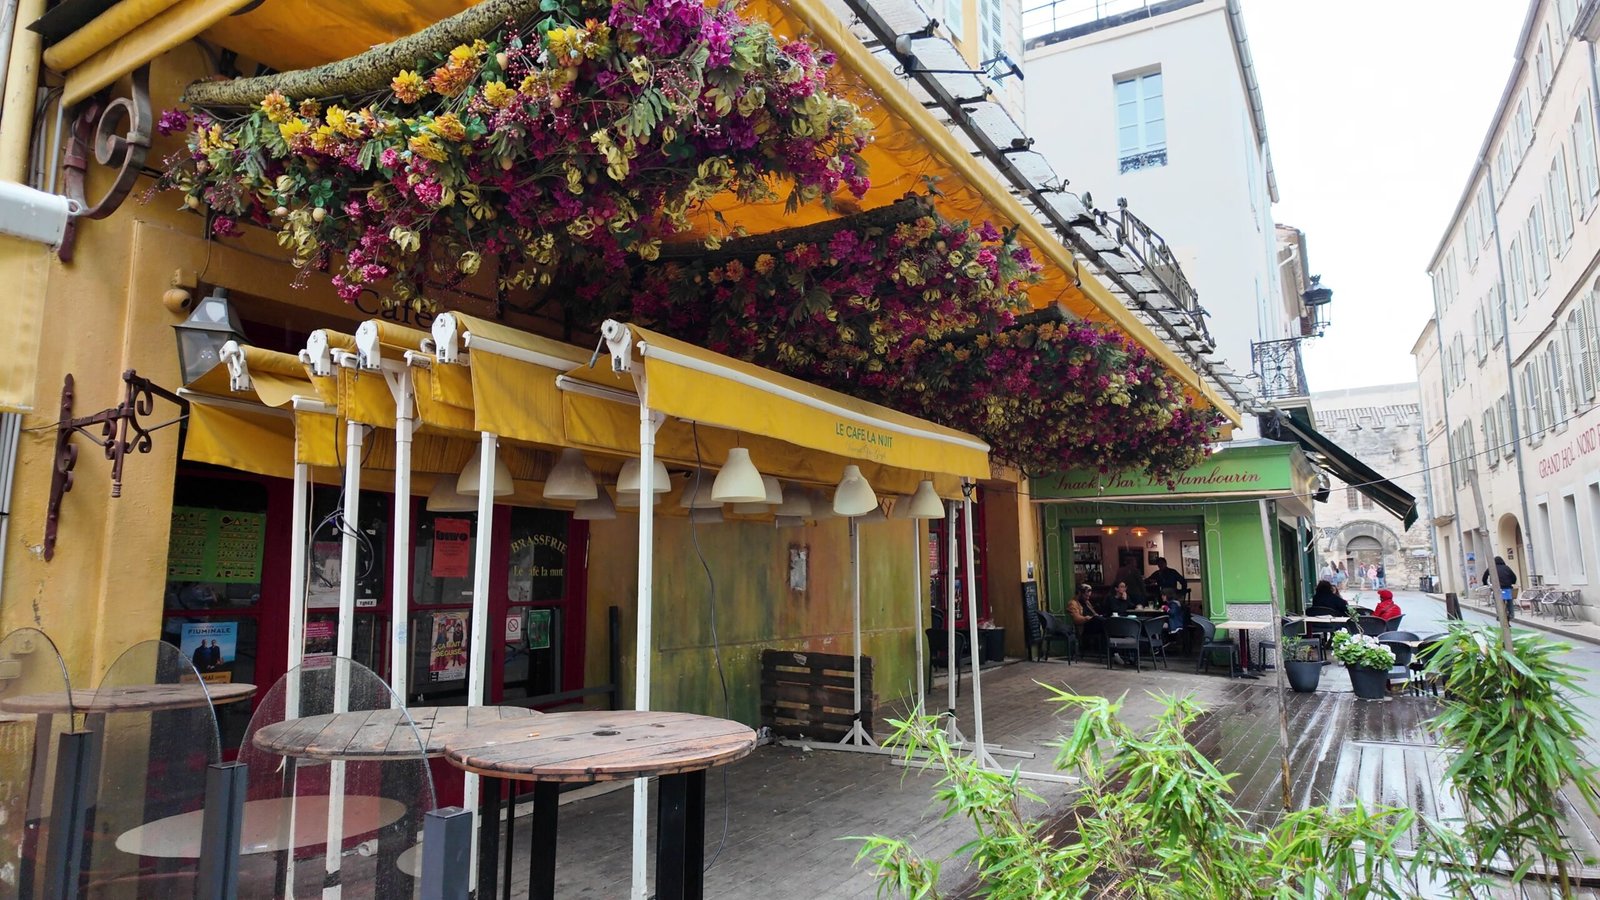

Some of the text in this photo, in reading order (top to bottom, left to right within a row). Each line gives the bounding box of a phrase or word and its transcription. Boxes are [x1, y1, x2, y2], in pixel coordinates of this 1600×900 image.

[835, 421, 844, 436] LE
[866, 430, 876, 445] LA
[878, 433, 893, 448] NUIT
[1539, 453, 1560, 478] GRAND
[1577, 427, 1596, 457] NORD
[1052, 473, 1096, 490] Snack
[1107, 472, 1135, 488] Bar
[1174, 466, 1260, 487] Tambourin
[511, 534, 568, 554] BRASSERIE
[513, 565, 524, 576] Le
[541, 565, 548, 576] la
[549, 566, 563, 576] nuit
[187, 627, 231, 635] FIUMINALE
